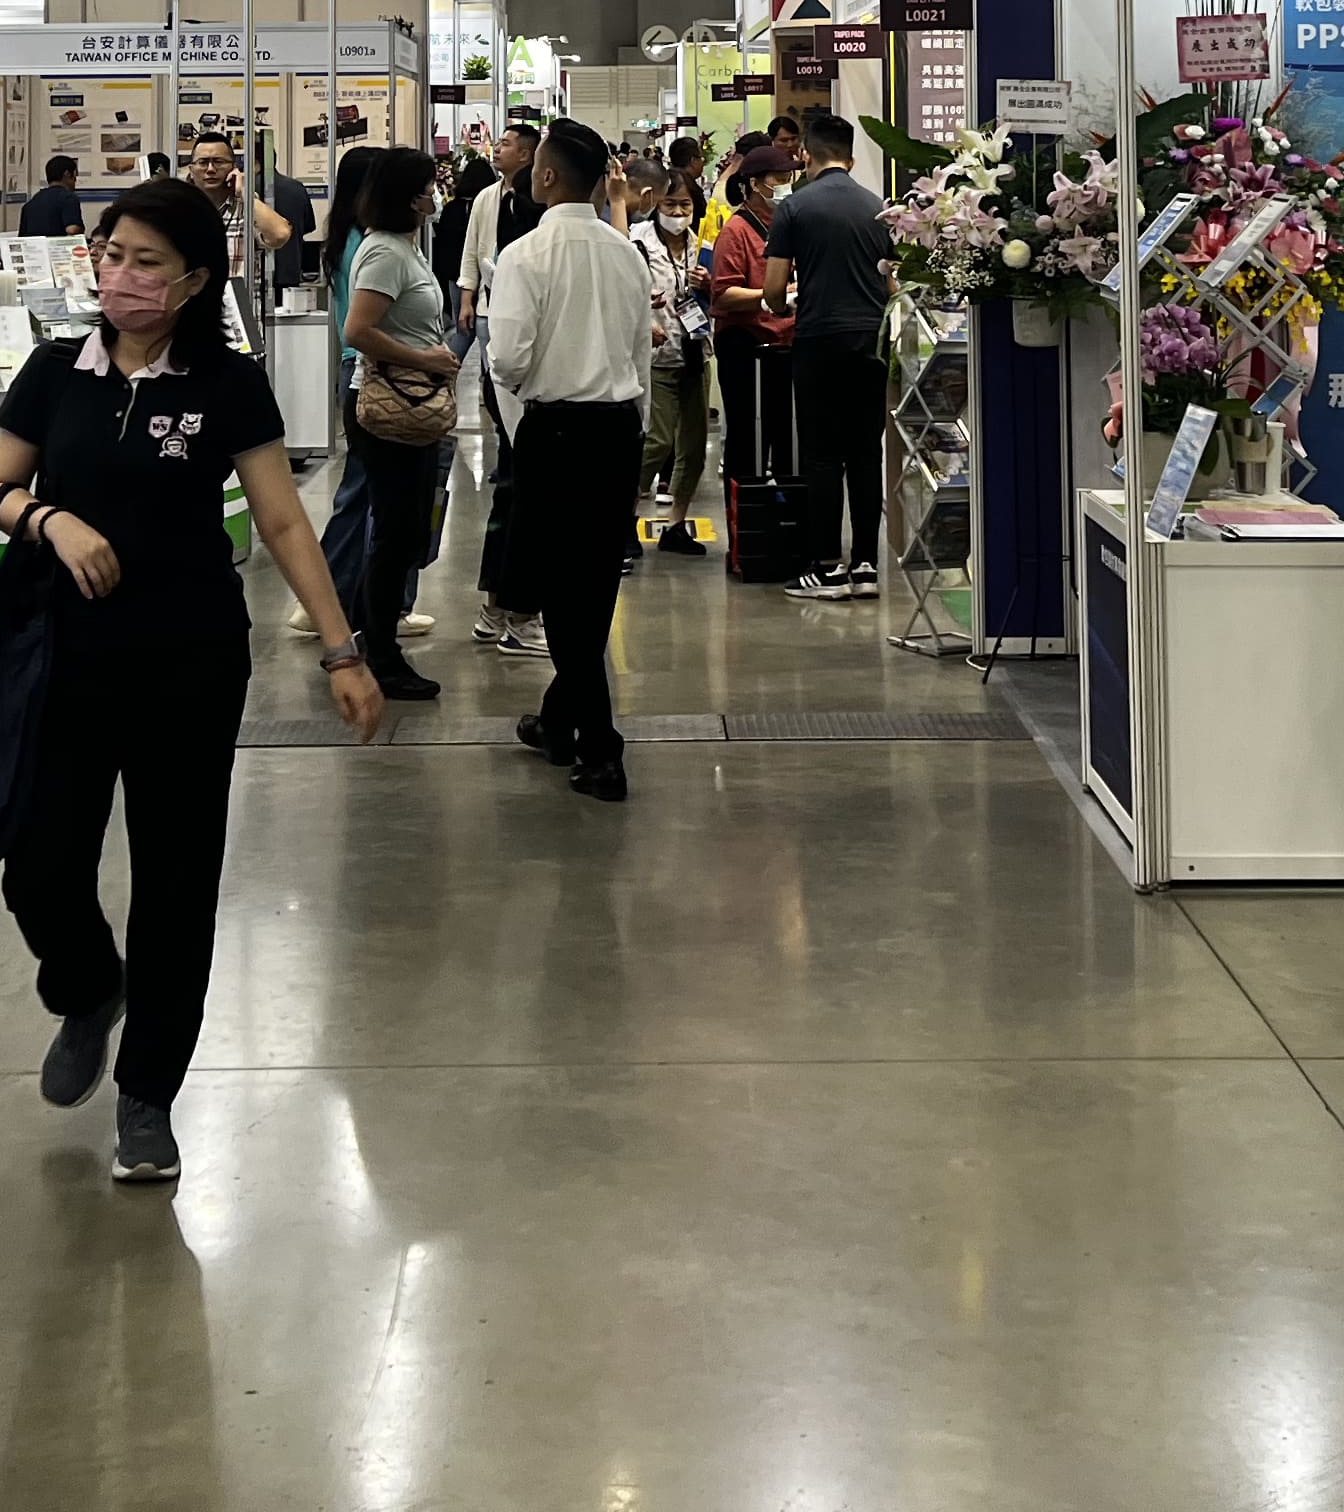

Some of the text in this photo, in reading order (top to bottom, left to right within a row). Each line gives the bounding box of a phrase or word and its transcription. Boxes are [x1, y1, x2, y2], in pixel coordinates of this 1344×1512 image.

[906, 10, 946, 22] L0021
[82, 34, 257, 50] 台安計算儀有限公
[833, 42, 866, 52] L0020
[66, 52, 112, 62] TAIWAN
[115, 52, 159, 62] OFFICE
[161, 52, 217, 62] MCHINE
